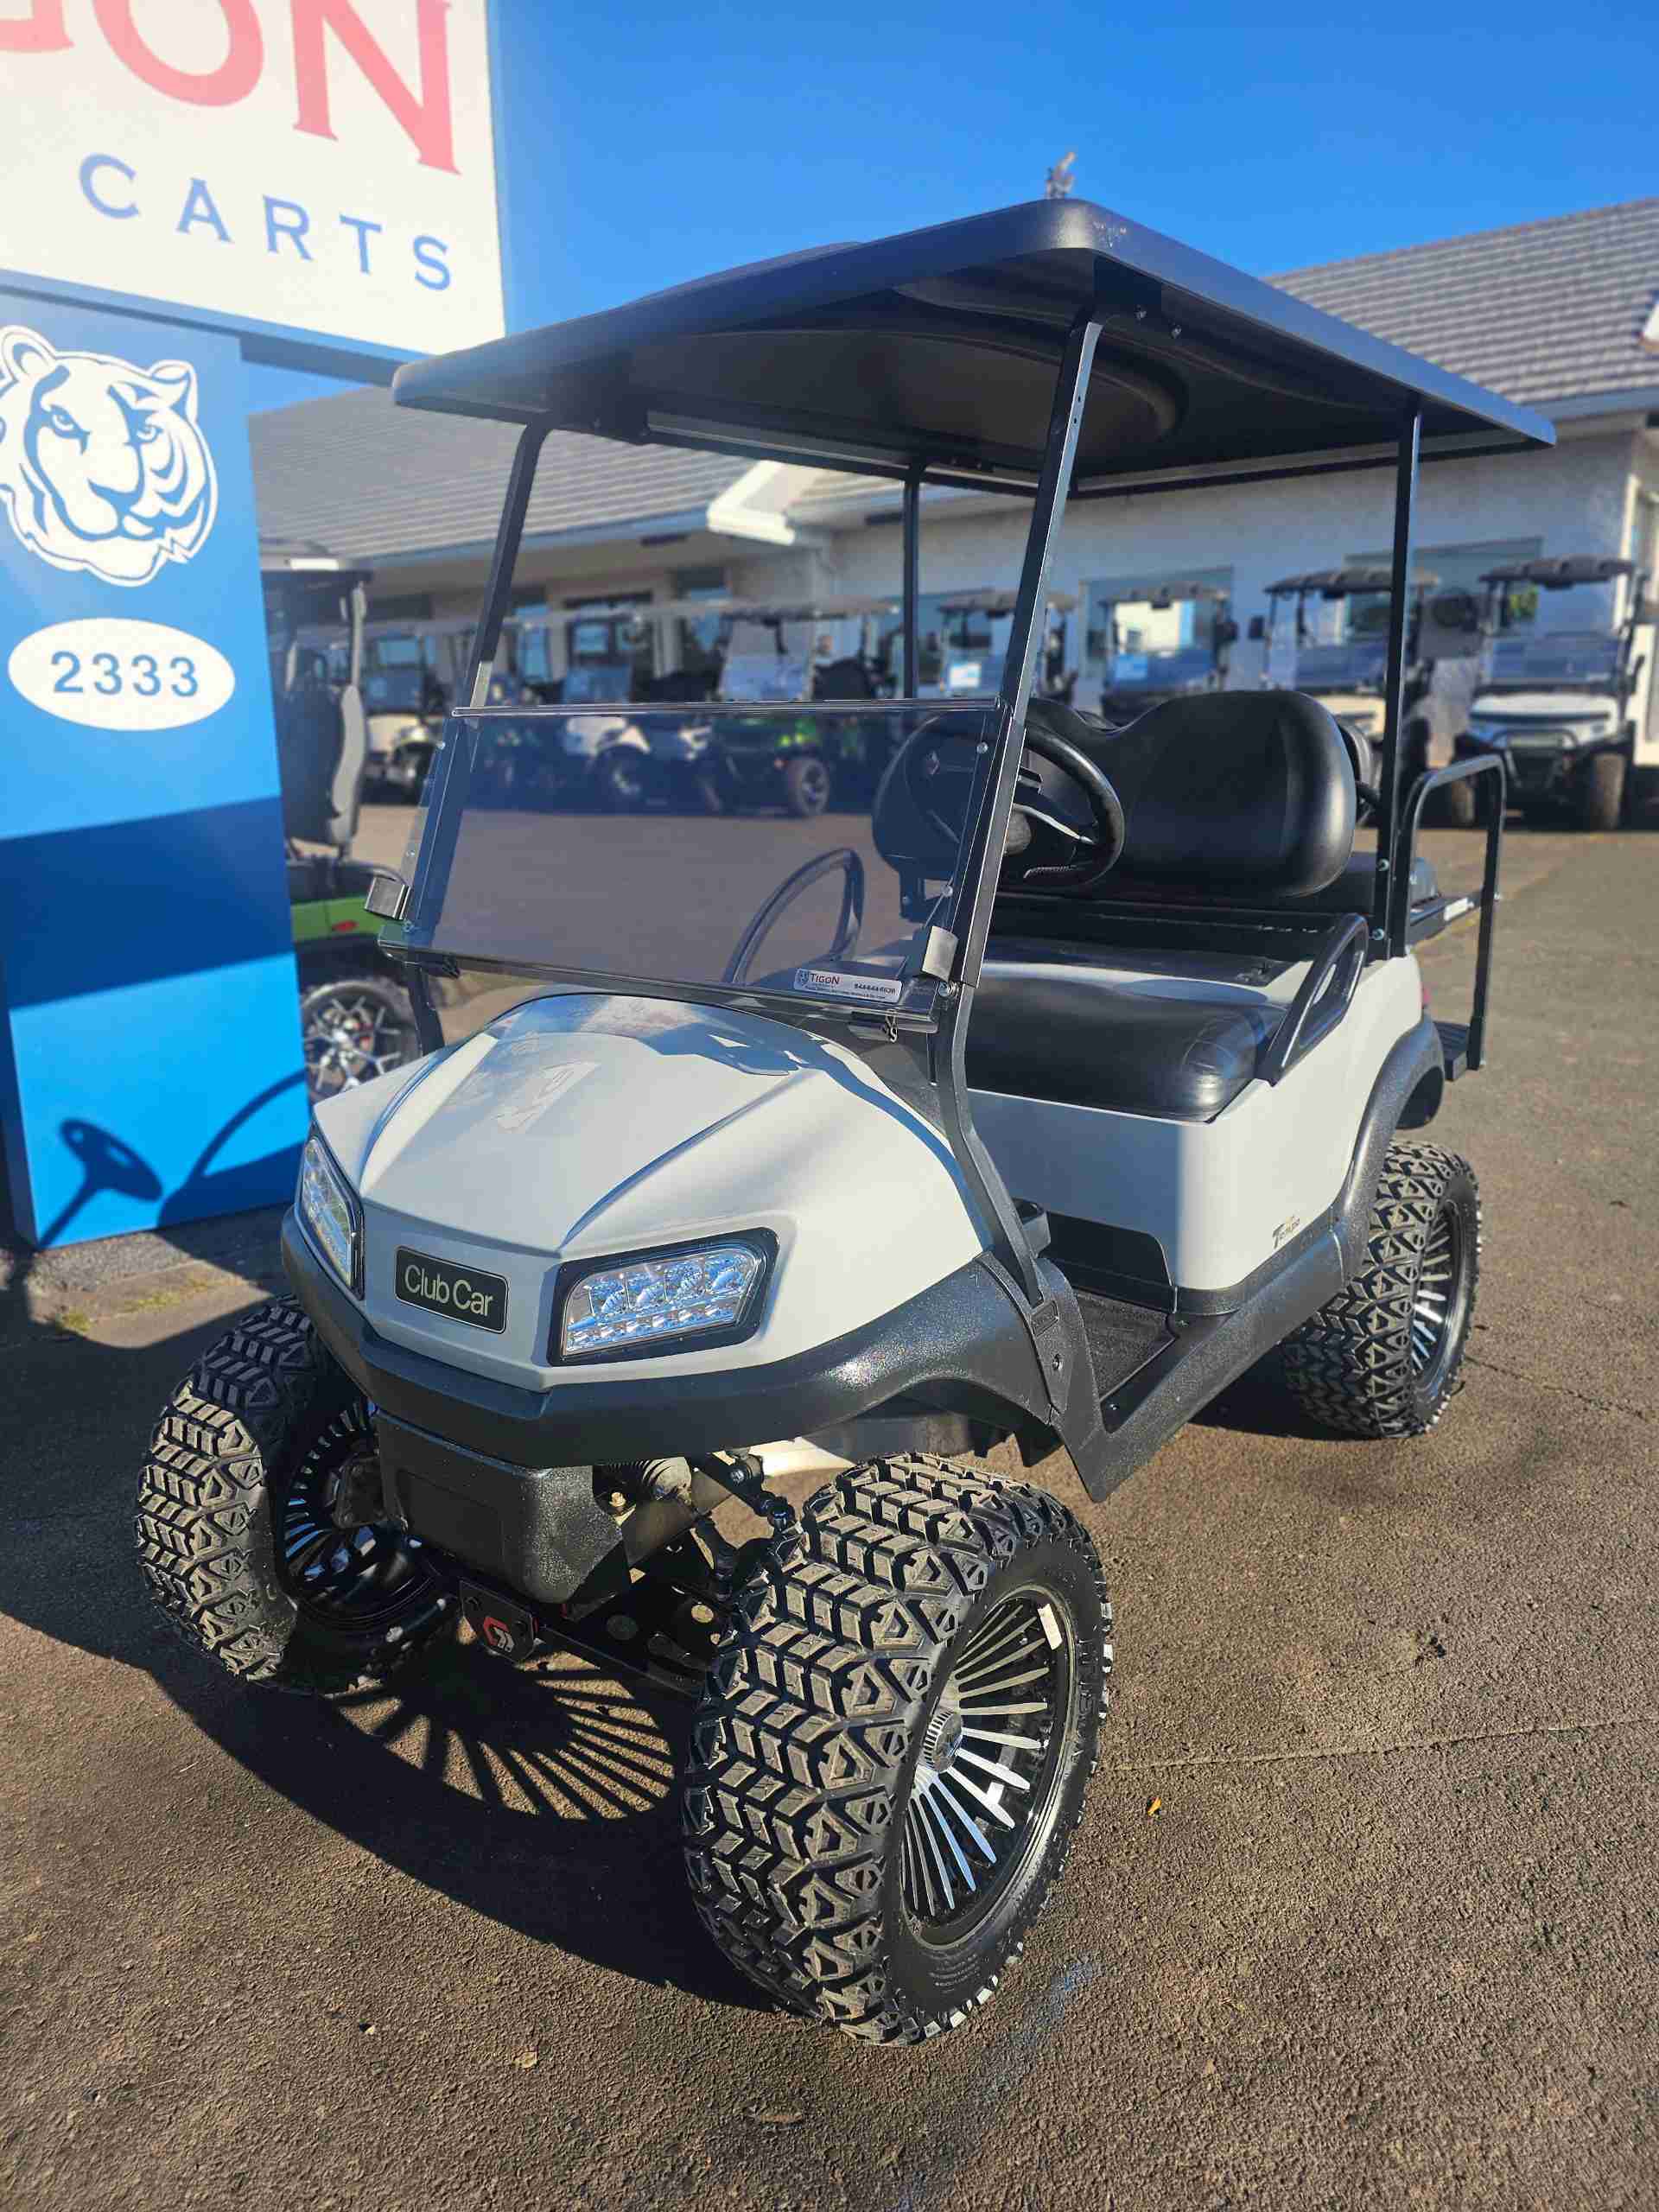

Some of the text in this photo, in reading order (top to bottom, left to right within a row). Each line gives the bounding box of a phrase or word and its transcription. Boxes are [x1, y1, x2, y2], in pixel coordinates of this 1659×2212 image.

[78, 153, 452, 290] CARTS
[50, 651, 199, 697] 2333
[810, 973, 841, 985] TIGON
[405, 1264, 493, 1316] Club Car
